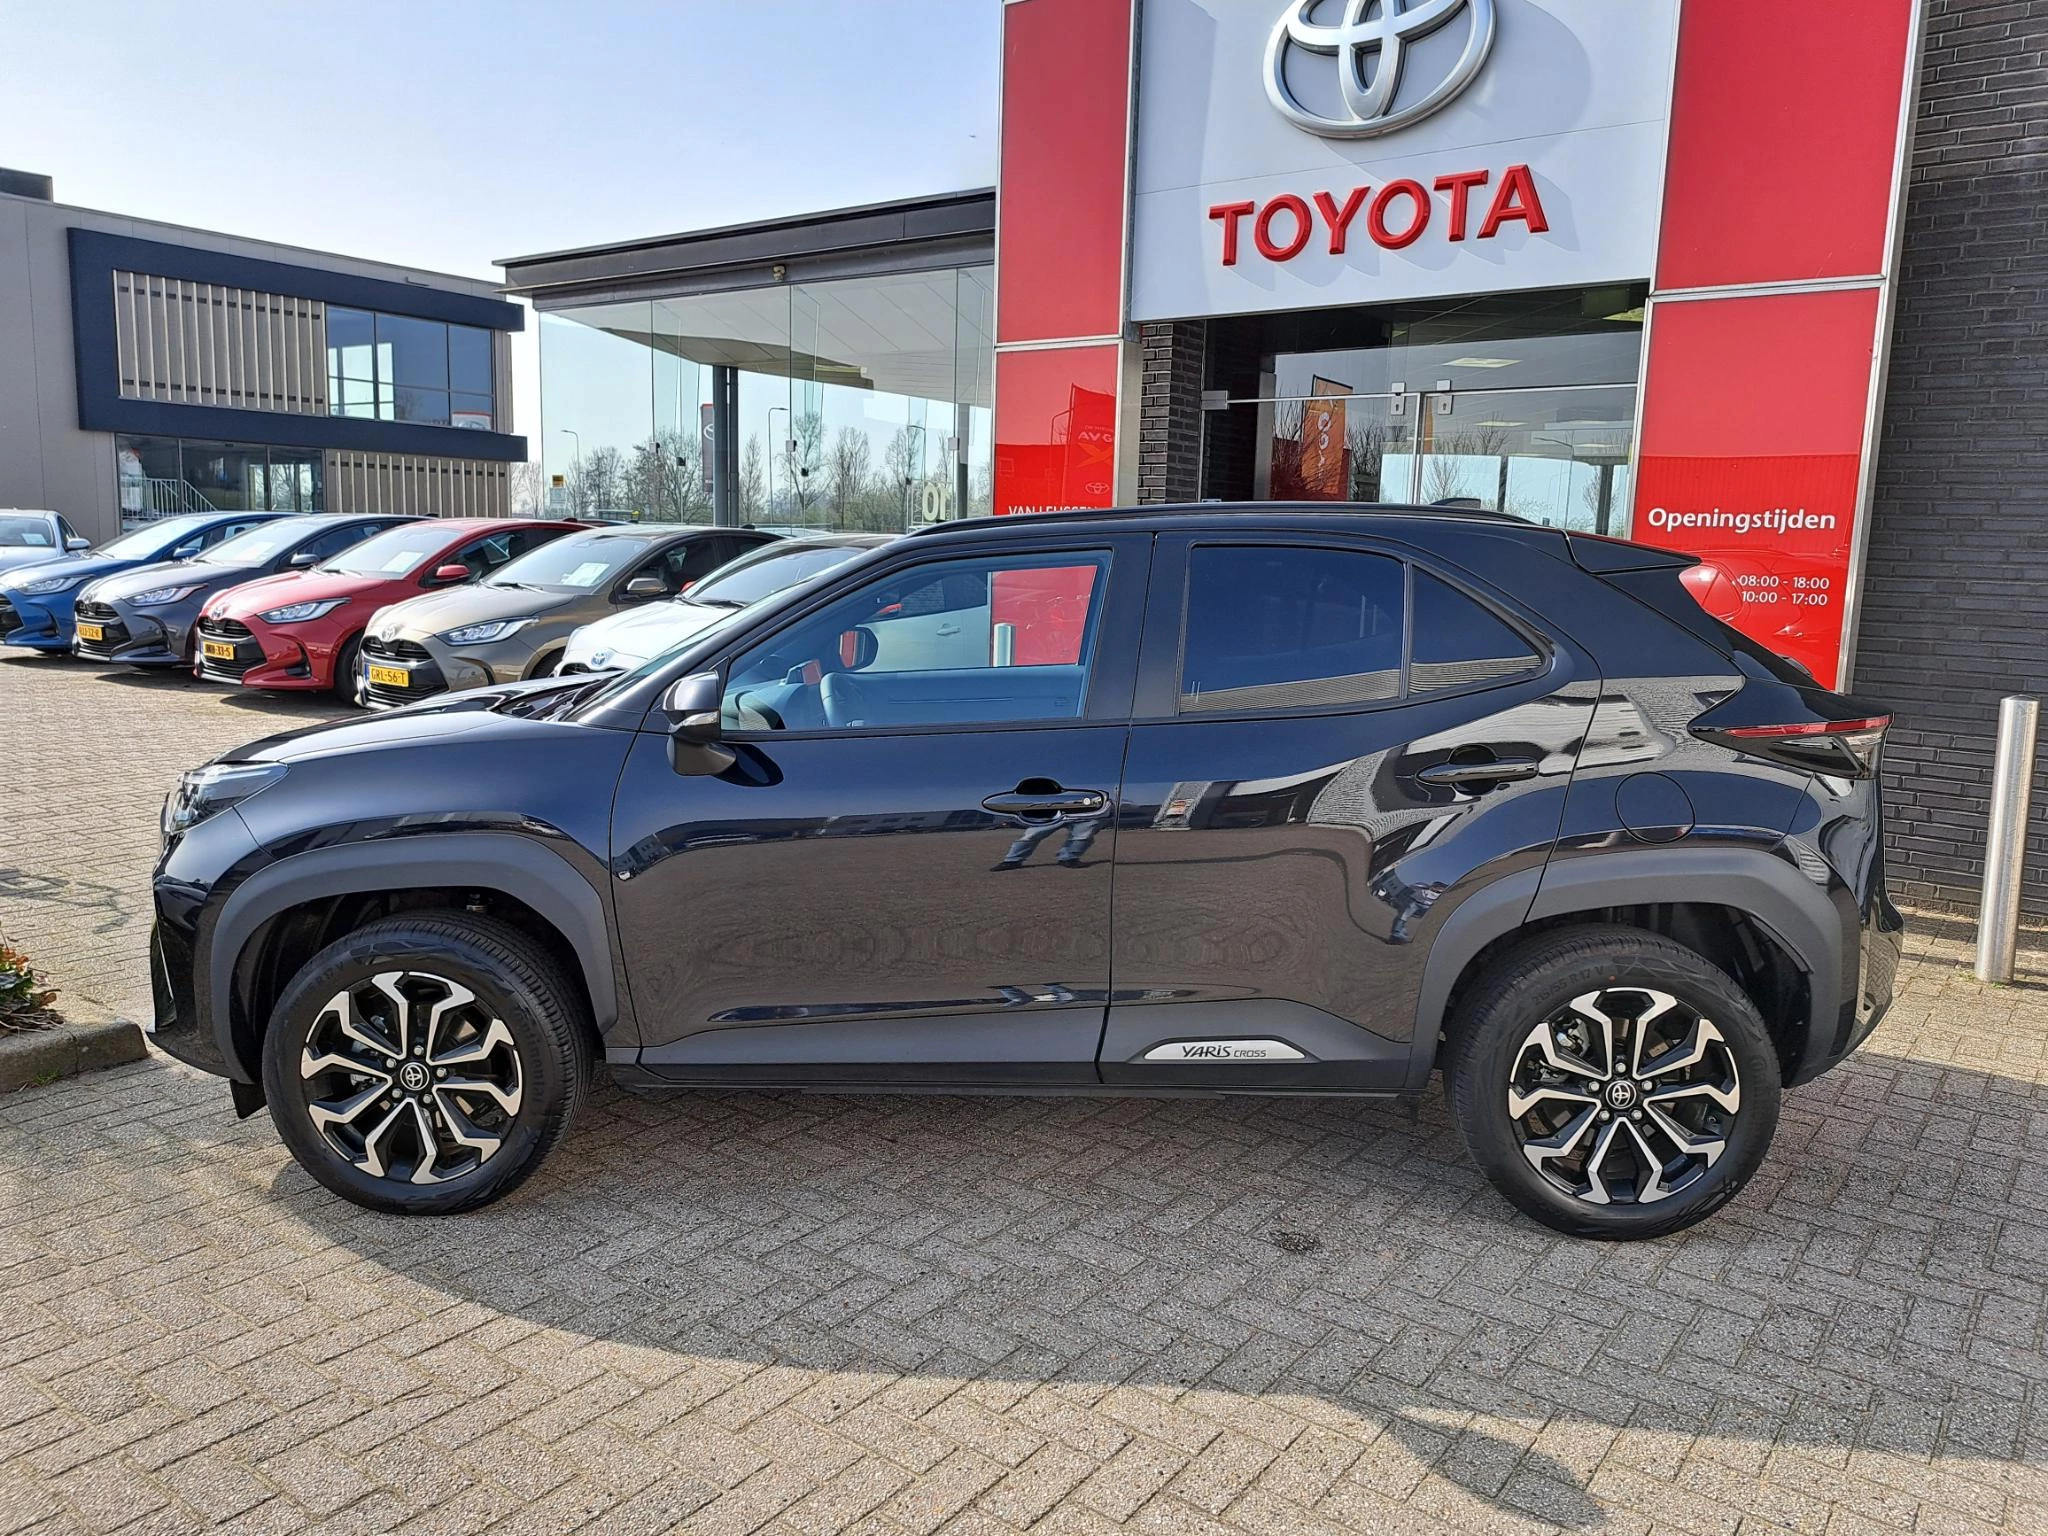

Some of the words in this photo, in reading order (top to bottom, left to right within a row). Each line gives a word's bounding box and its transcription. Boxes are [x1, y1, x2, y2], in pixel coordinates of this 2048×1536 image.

[1208, 164, 1549, 266] TOYOTA
[1648, 508, 1836, 534] Openingstijden
[1740, 575, 1779, 588] 08:00
[1793, 577, 1829, 589] 18:00
[1742, 591, 1777, 603] 10:00
[1792, 593, 1828, 606] 17:00
[371, 668, 405, 684] GRL-56-T
[1234, 1050, 1267, 1058] CROSS
